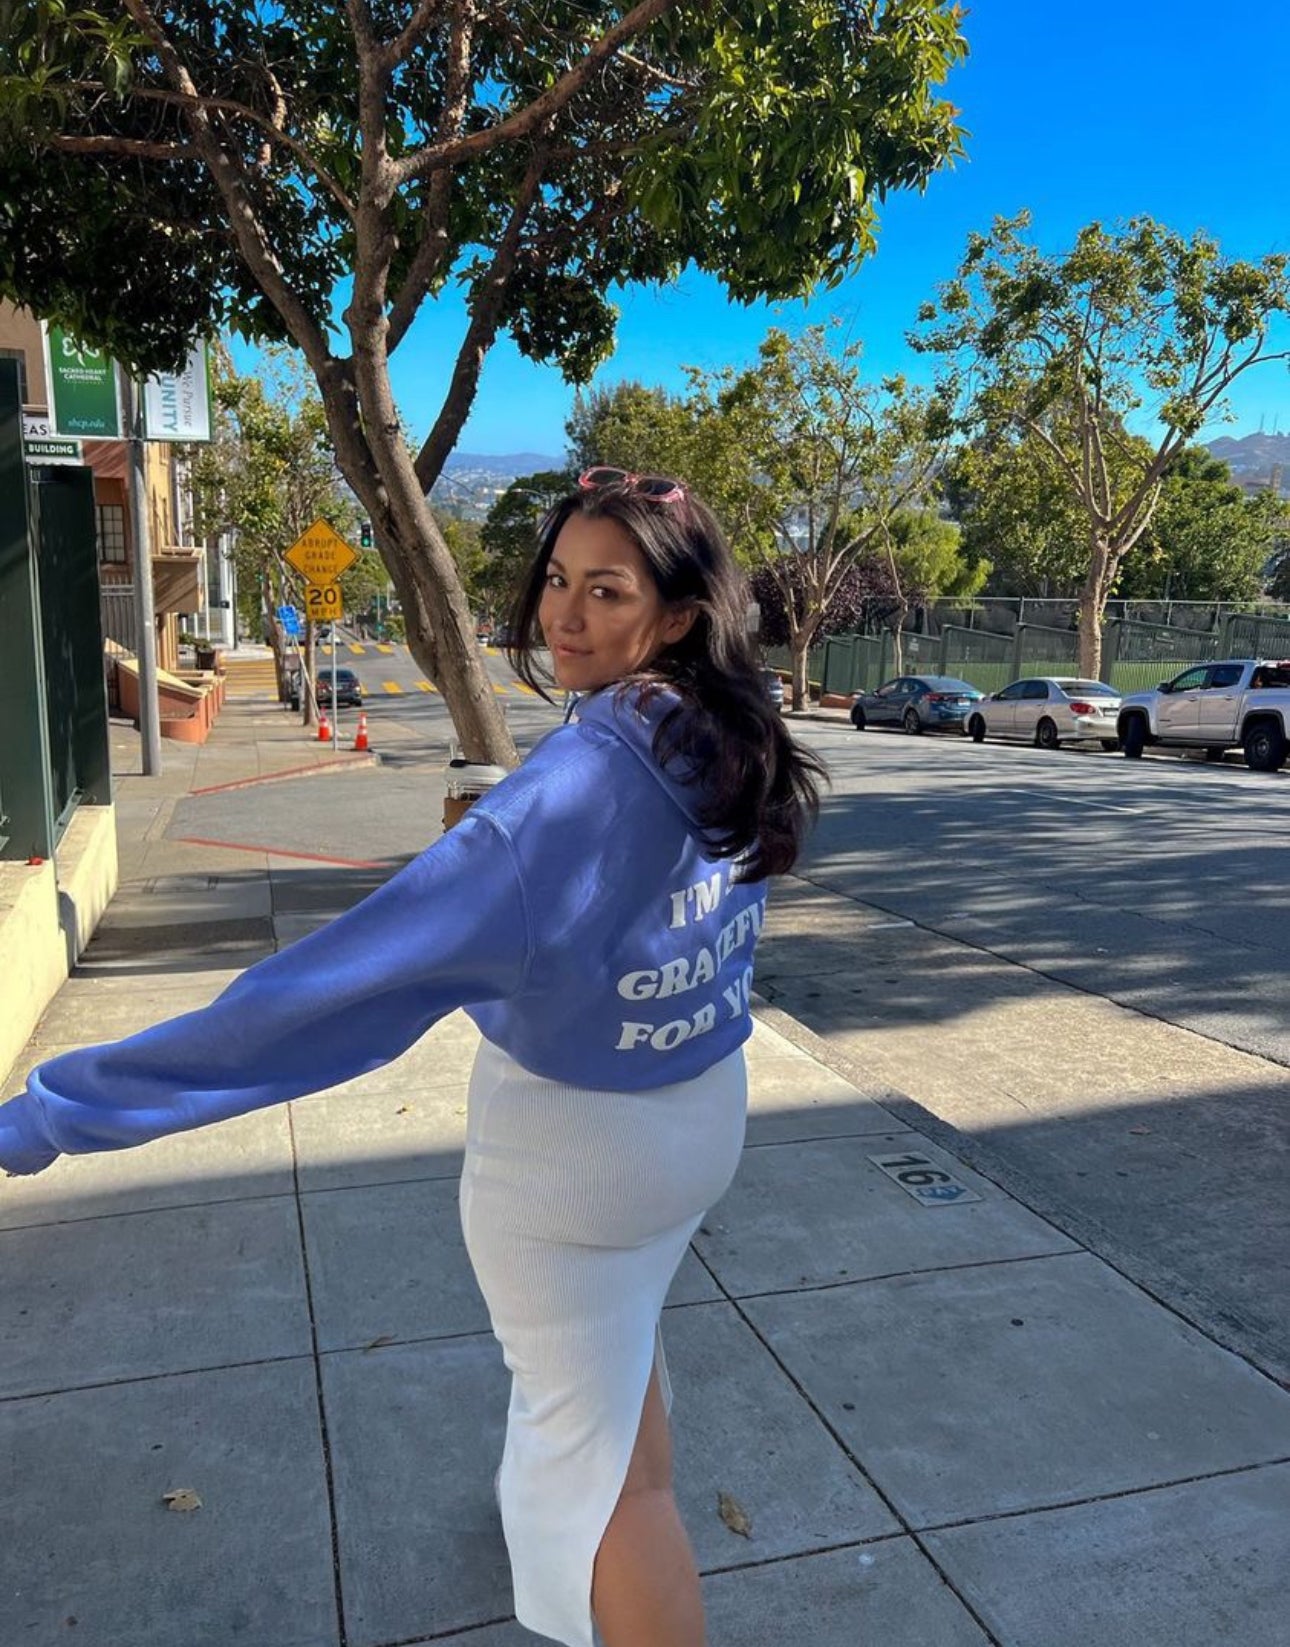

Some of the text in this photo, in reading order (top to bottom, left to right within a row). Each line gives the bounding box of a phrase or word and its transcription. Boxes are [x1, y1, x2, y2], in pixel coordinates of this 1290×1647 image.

[161, 375, 178, 432] UNITY
[182, 391, 194, 427] Pursue
[28, 443, 75, 456] BUILDING
[302, 538, 338, 547] ABRUPT
[305, 551, 335, 560] GRADE
[303, 565, 338, 573] CHANGE
[309, 588, 337, 605] 20
[311, 608, 337, 617] MPH
[669, 872, 722, 929] I'M
[614, 1002, 717, 1052] FOR
